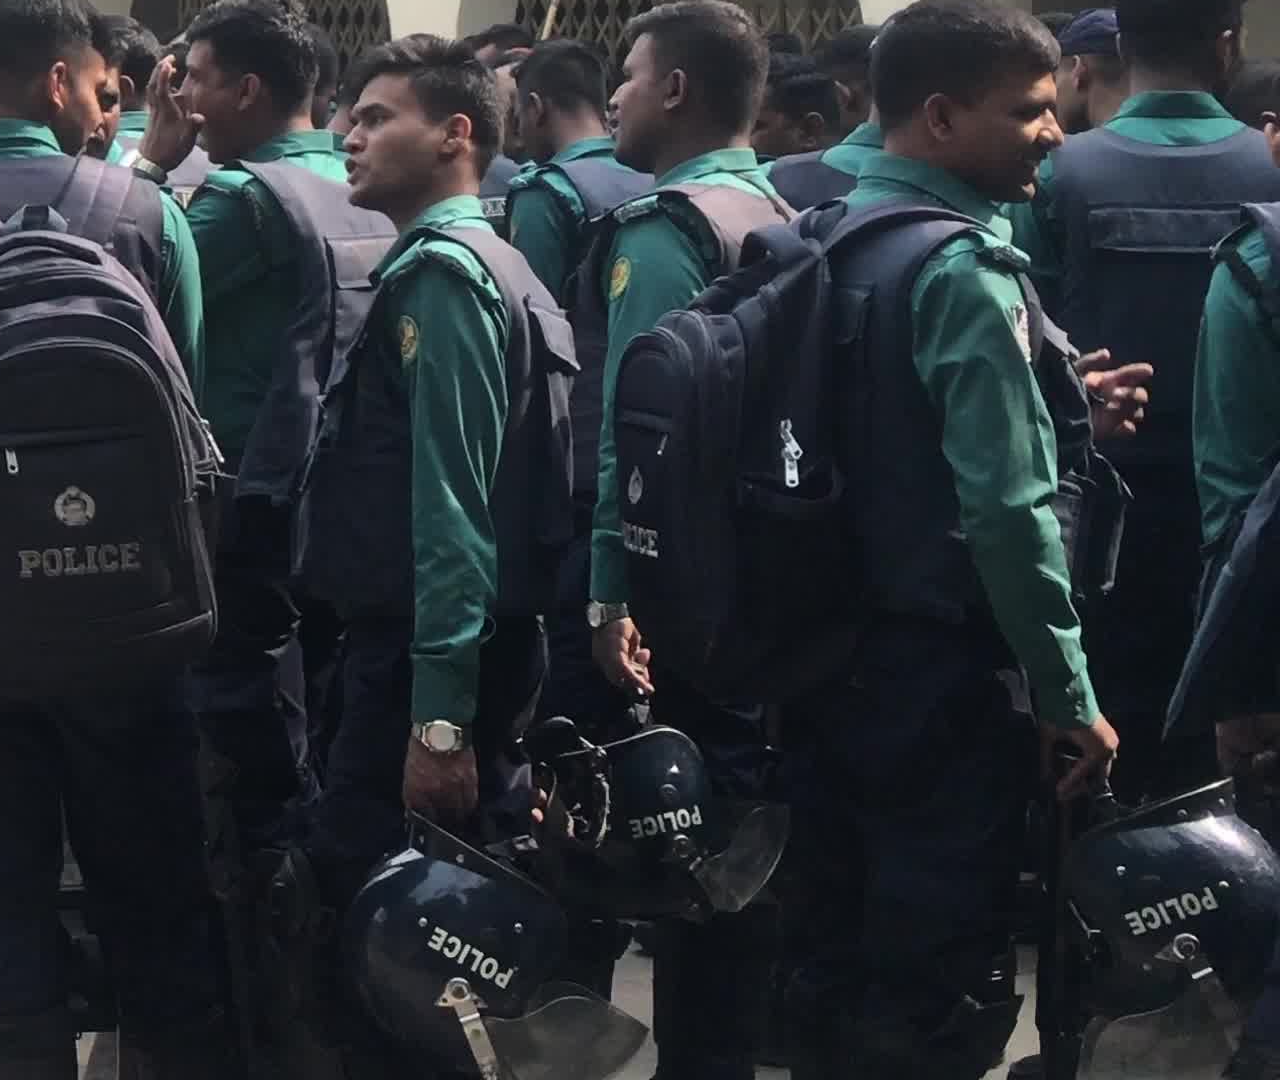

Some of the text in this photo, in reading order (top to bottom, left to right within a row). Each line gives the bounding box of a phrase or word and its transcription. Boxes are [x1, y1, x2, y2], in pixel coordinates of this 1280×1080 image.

[18, 542, 140, 578] POLICE
[628, 805, 703, 839] POLICE
[1124, 886, 1219, 936] POLICE
[427, 927, 514, 989] POLICE
